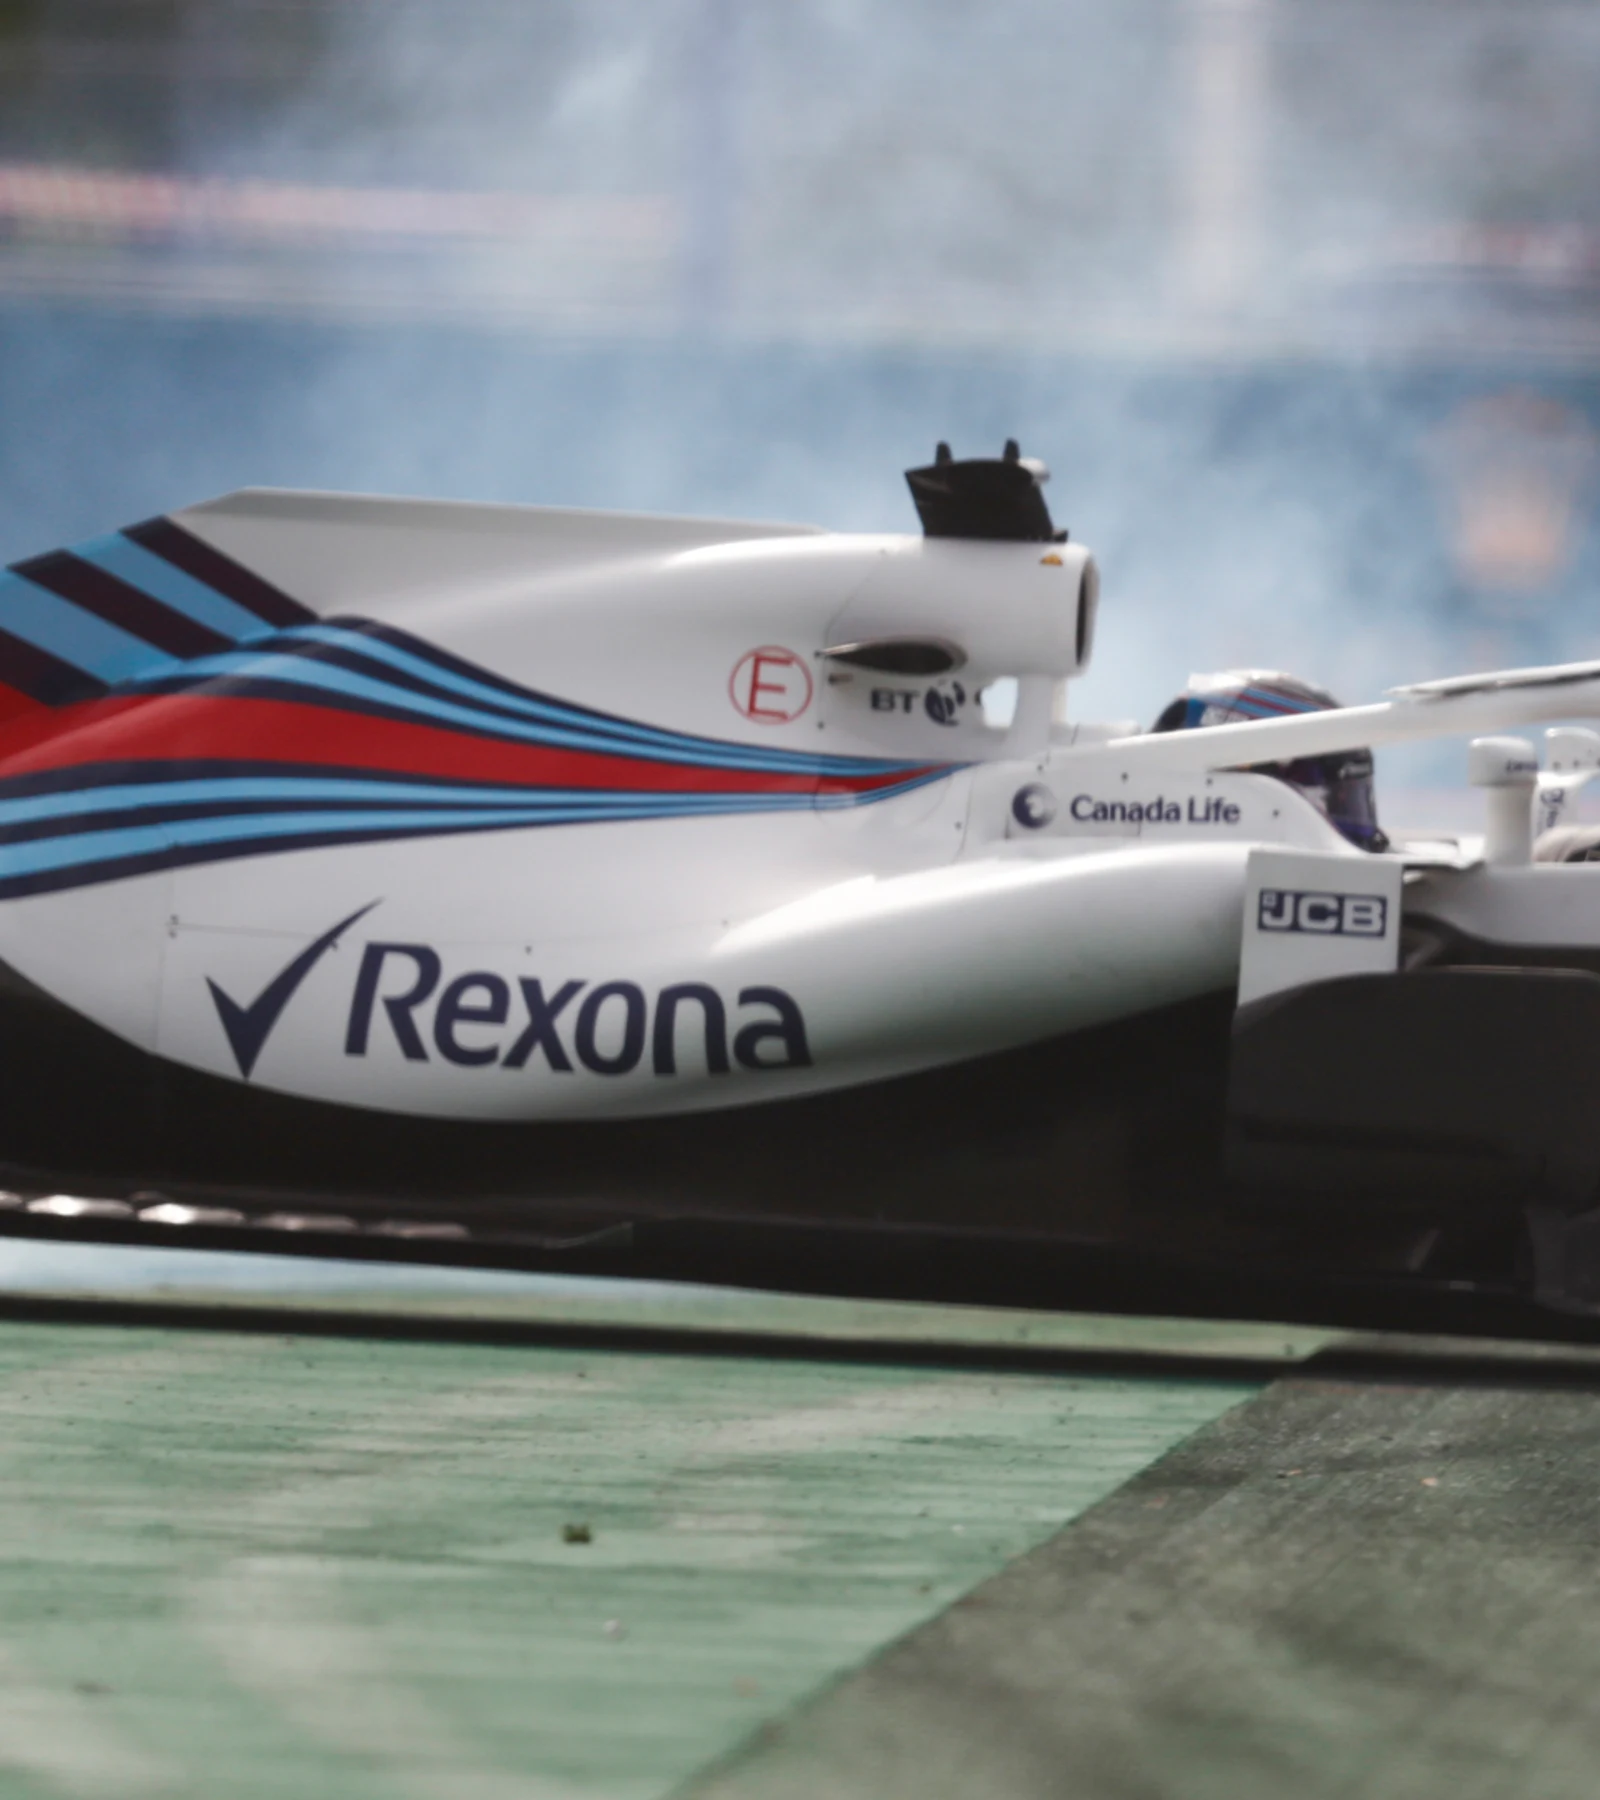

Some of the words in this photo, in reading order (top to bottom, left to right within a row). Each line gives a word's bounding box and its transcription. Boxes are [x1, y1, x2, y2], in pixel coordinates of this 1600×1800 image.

[748, 655, 793, 719] E
[871, 688, 920, 713] BT
[1070, 794, 1181, 824] Canada
[1188, 796, 1240, 824] Life
[1261, 892, 1384, 934] JCB
[344, 941, 813, 1076] Rexona
